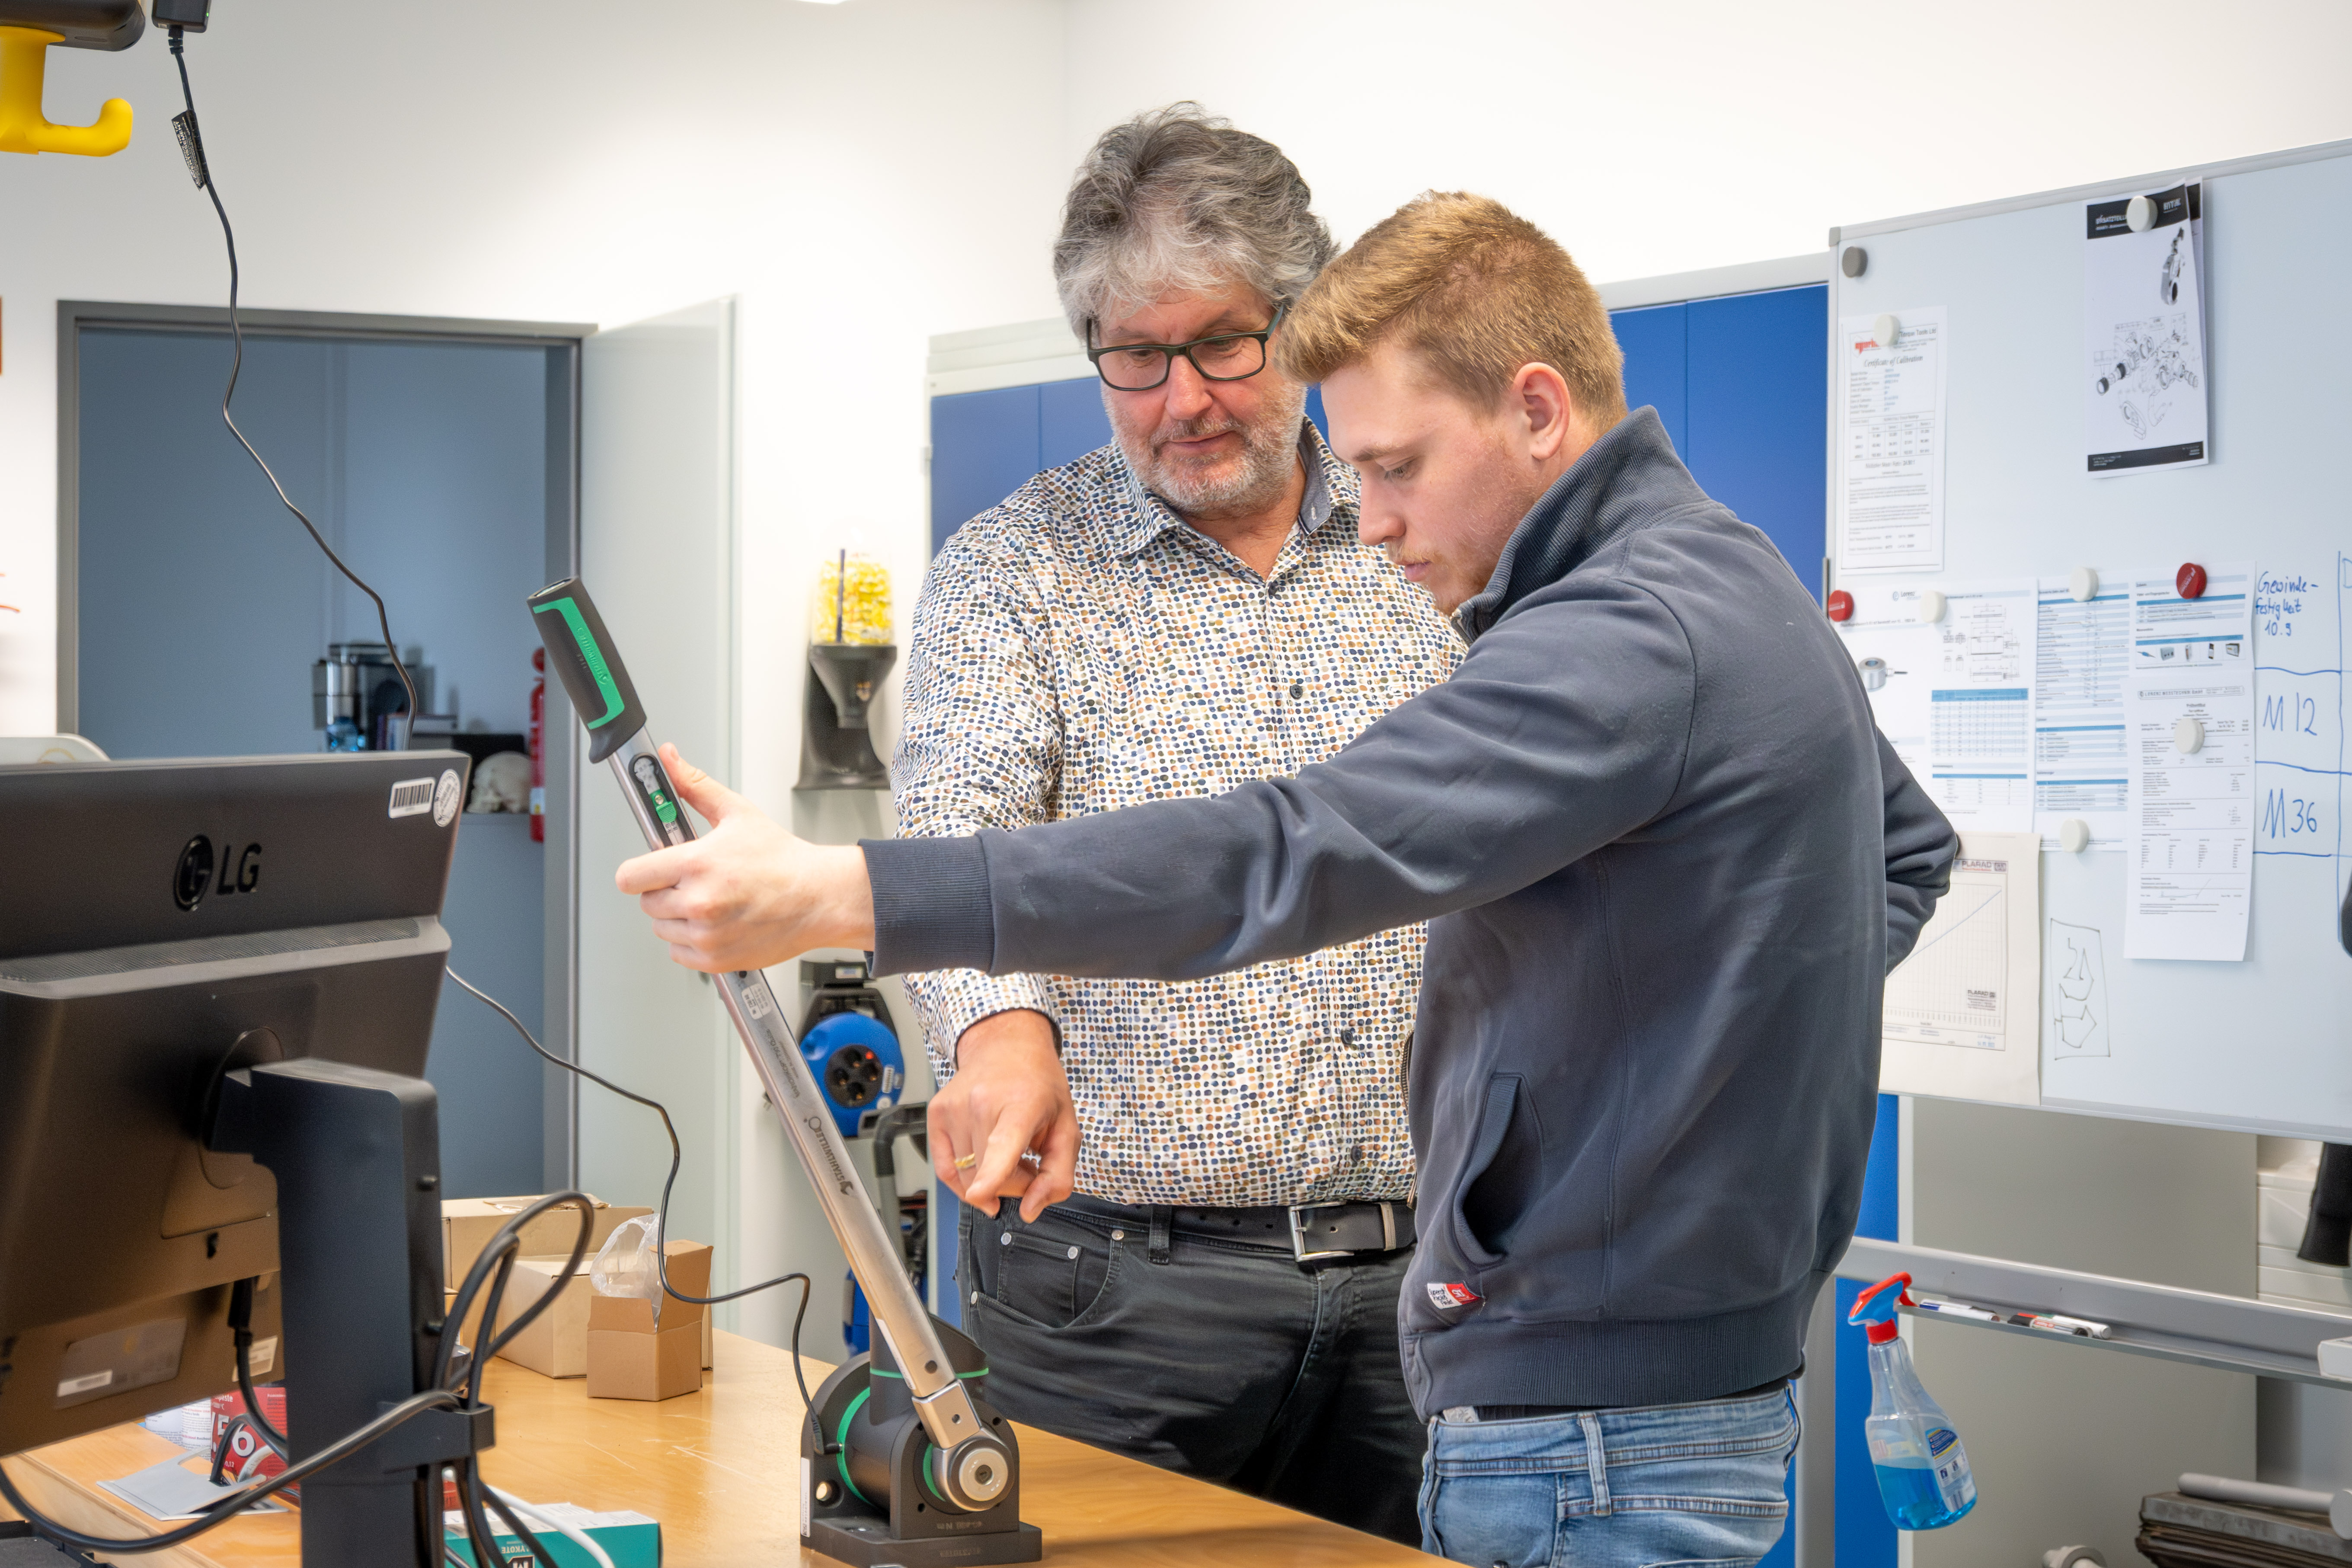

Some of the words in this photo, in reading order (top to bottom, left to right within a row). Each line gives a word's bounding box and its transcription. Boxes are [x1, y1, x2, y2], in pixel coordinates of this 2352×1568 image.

[1864, 358, 1889, 368] Certificate
[1890, 357, 1896, 367] of
[1897, 355, 1923, 364] Calibration
[217, 843, 262, 895] LG
[816, 1130, 845, 1182] STAHLWILLE
